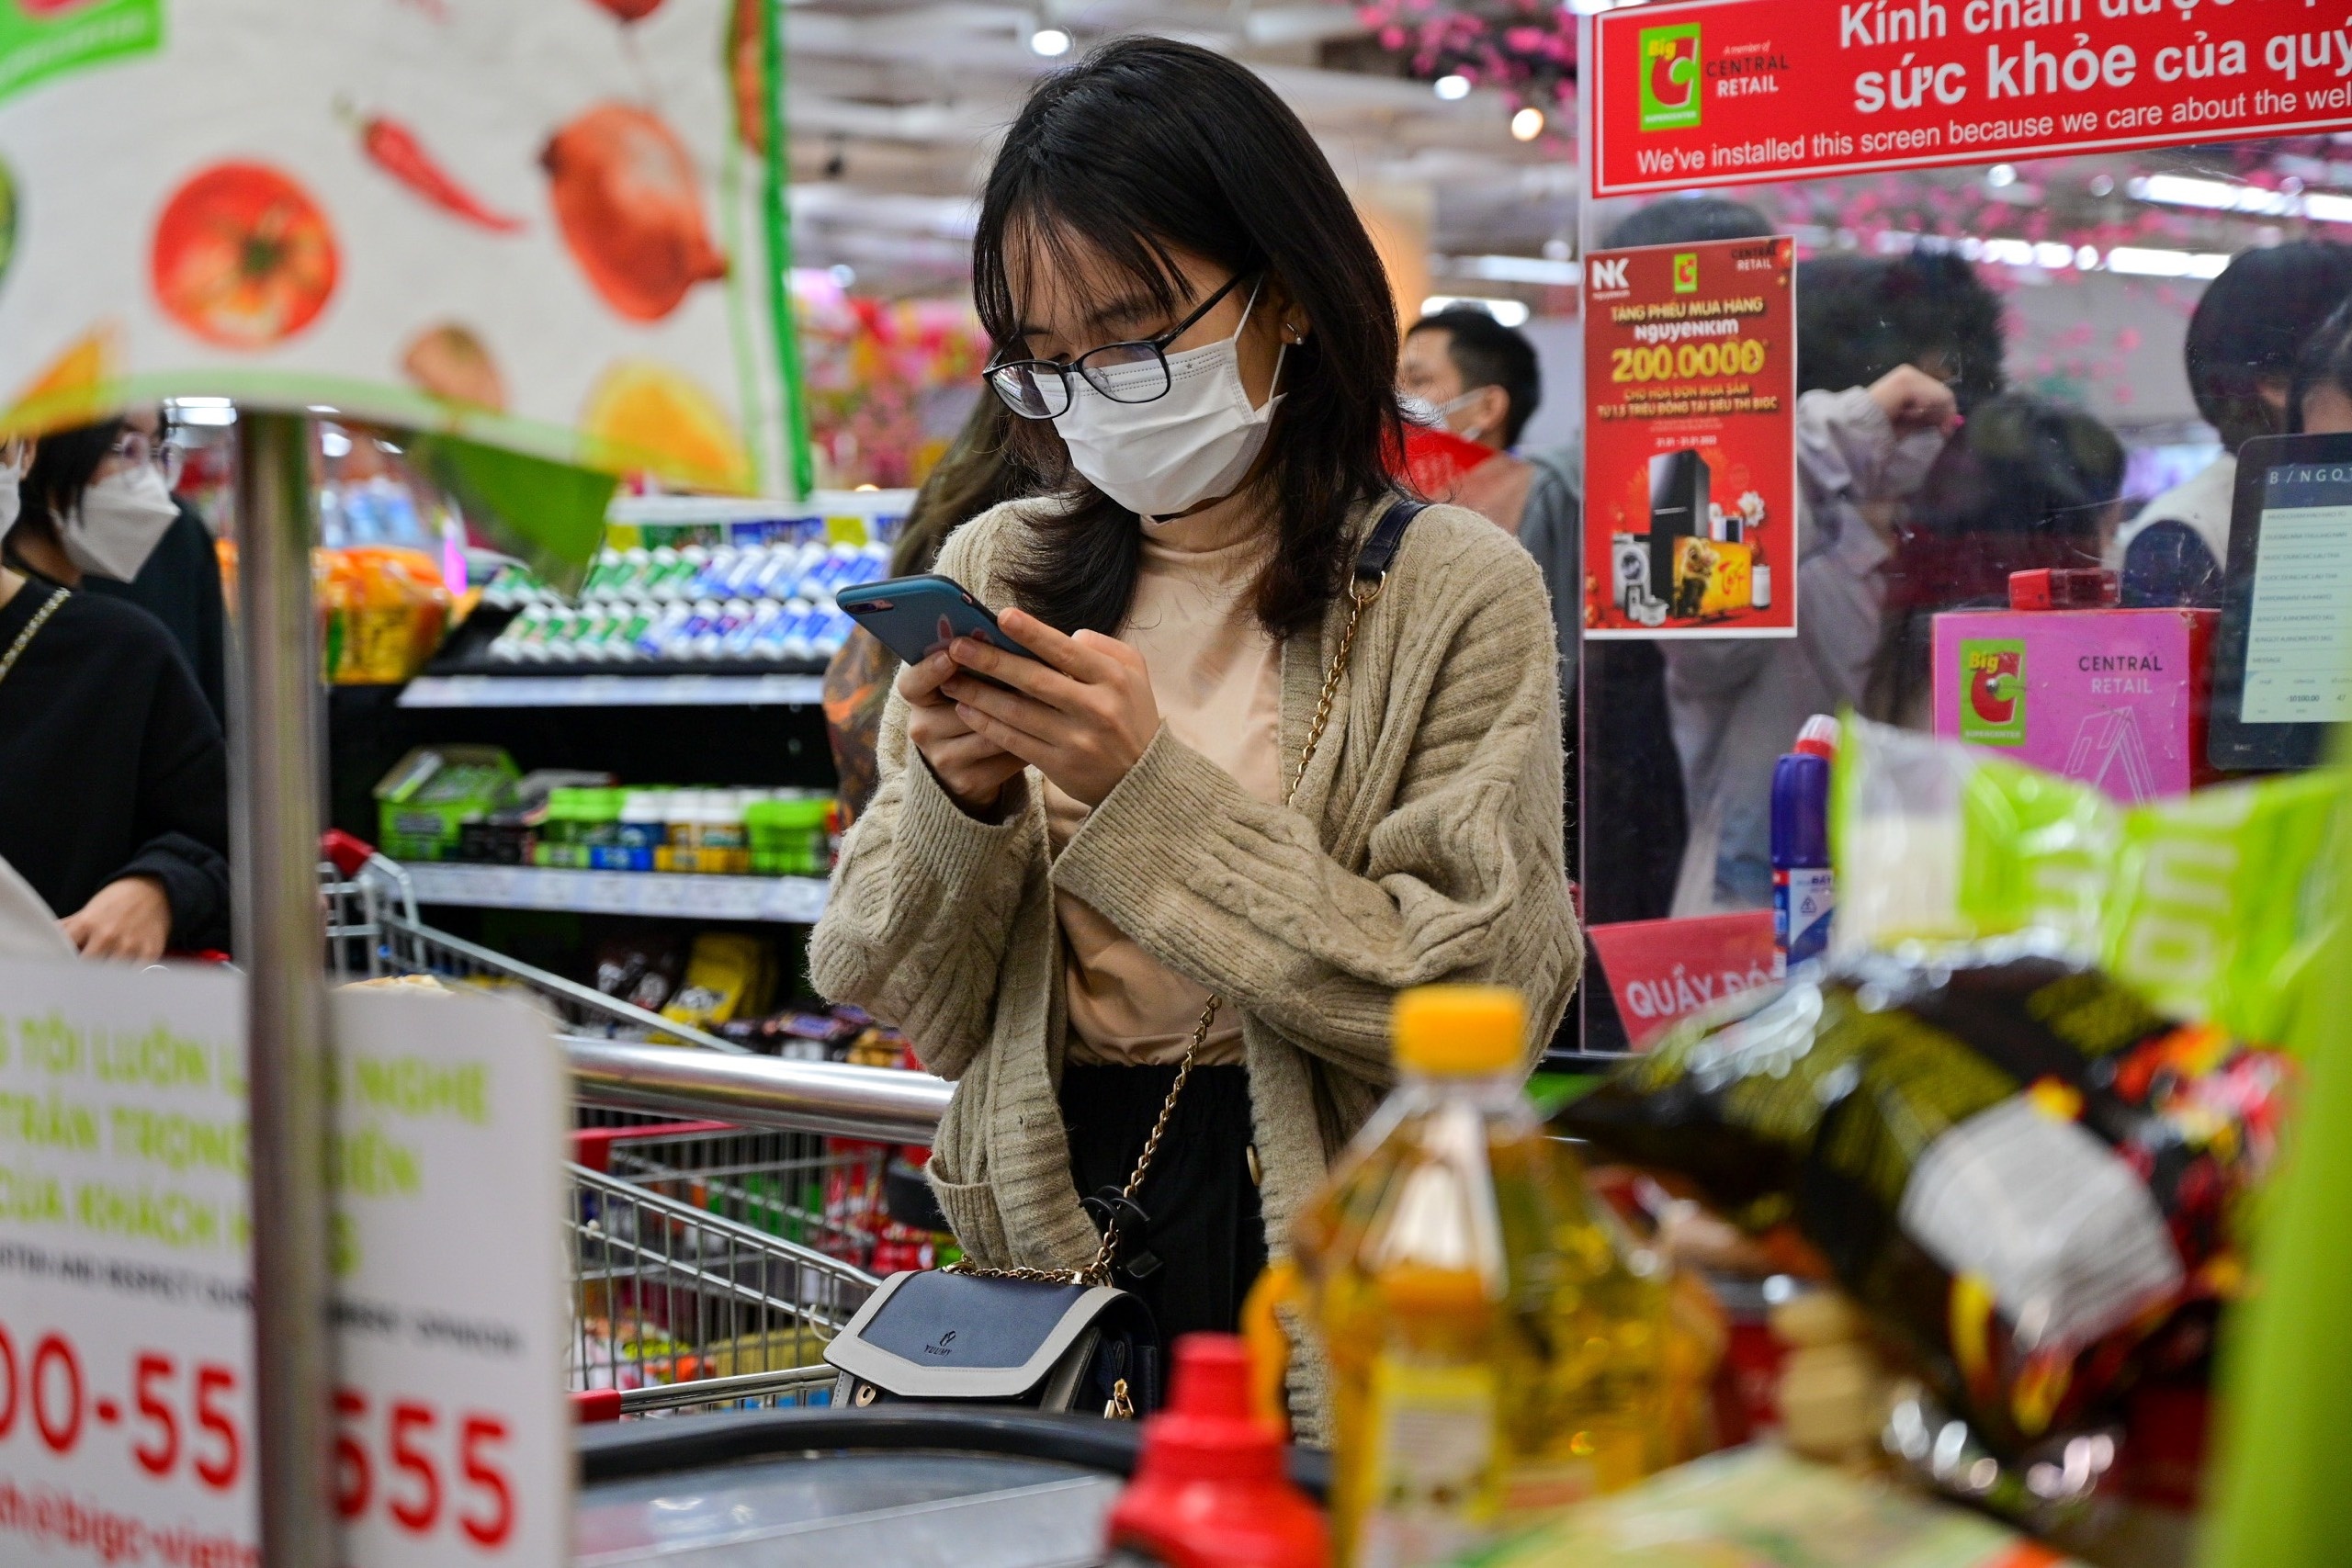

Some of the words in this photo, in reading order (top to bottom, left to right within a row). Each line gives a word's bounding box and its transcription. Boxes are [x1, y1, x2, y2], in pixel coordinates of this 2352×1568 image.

[1840, 0, 1947, 48] Kính
[1647, 38, 1677, 61] Big
[1706, 54, 1790, 77] CENTRAL
[1854, 51, 1968, 113] sức
[1986, 32, 2137, 100] khỏe
[2154, 30, 2247, 82] của
[1717, 74, 1779, 98] RETAIL
[1636, 148, 1706, 175] We've
[1712, 135, 1805, 167] installed
[1812, 131, 1854, 157] this
[1861, 125, 1941, 153] screen
[1949, 118, 2054, 145] because
[2061, 111, 2098, 133] we
[2106, 105, 2163, 129] care
[2171, 93, 2247, 123] about
[2254, 88, 2298, 116] the
[1591, 257, 1631, 291] NK
[1736, 259, 1771, 272] RETAIL
[1689, 299, 1721, 317] MUA
[1968, 650, 2000, 673] Big
[2078, 656, 2164, 672] CENTRAL
[1970, 651, 2022, 725] C
[2090, 678, 2154, 694] RETAIL
